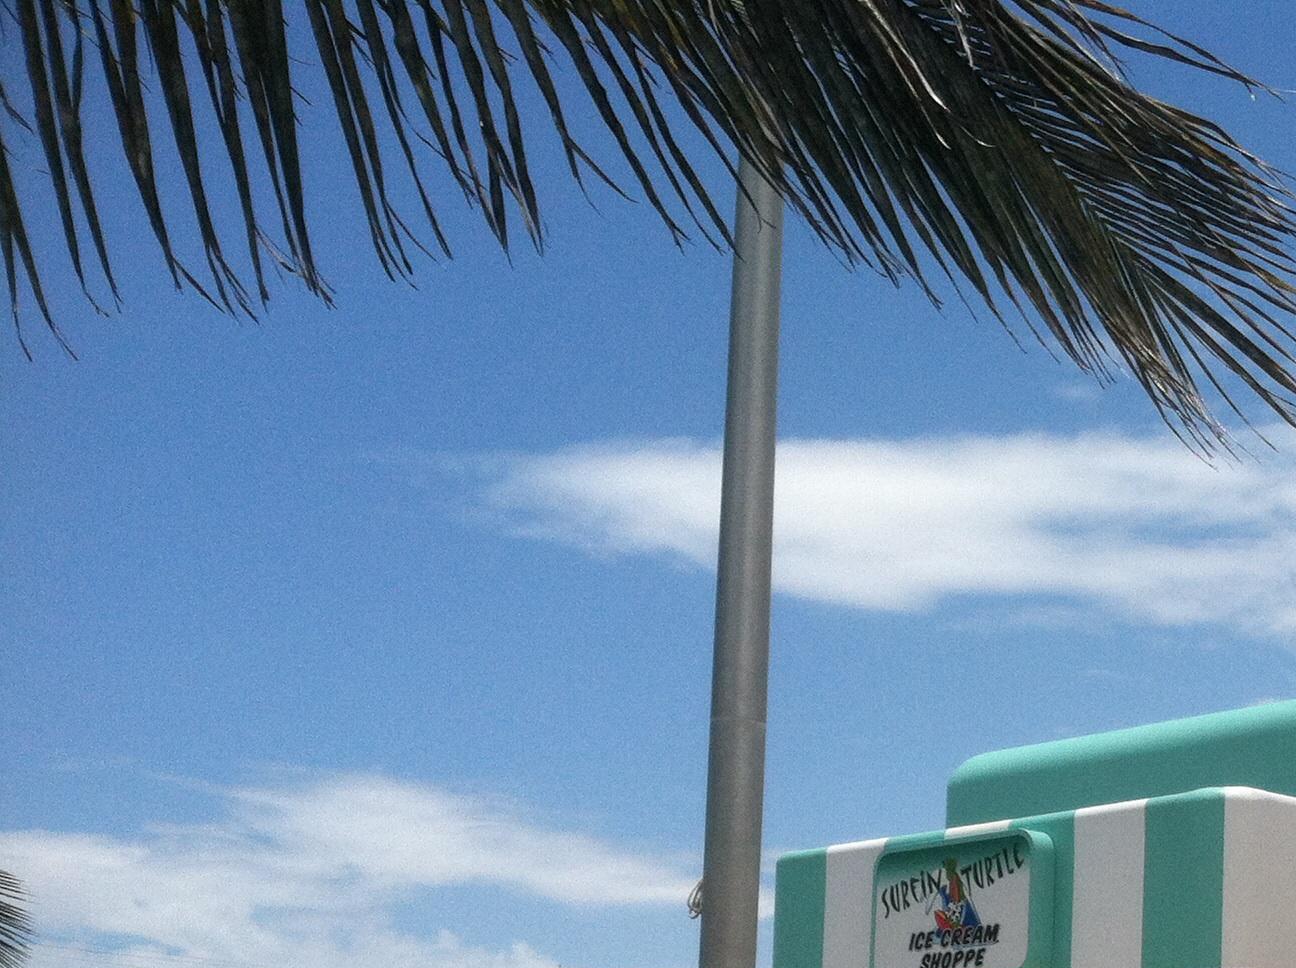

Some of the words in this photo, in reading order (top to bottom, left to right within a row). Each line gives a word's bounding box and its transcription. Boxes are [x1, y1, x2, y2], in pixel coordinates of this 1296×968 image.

[960, 843, 1025, 897] TURTLE
[909, 930, 935, 951] ICE
[940, 923, 1000, 947] CREAM
